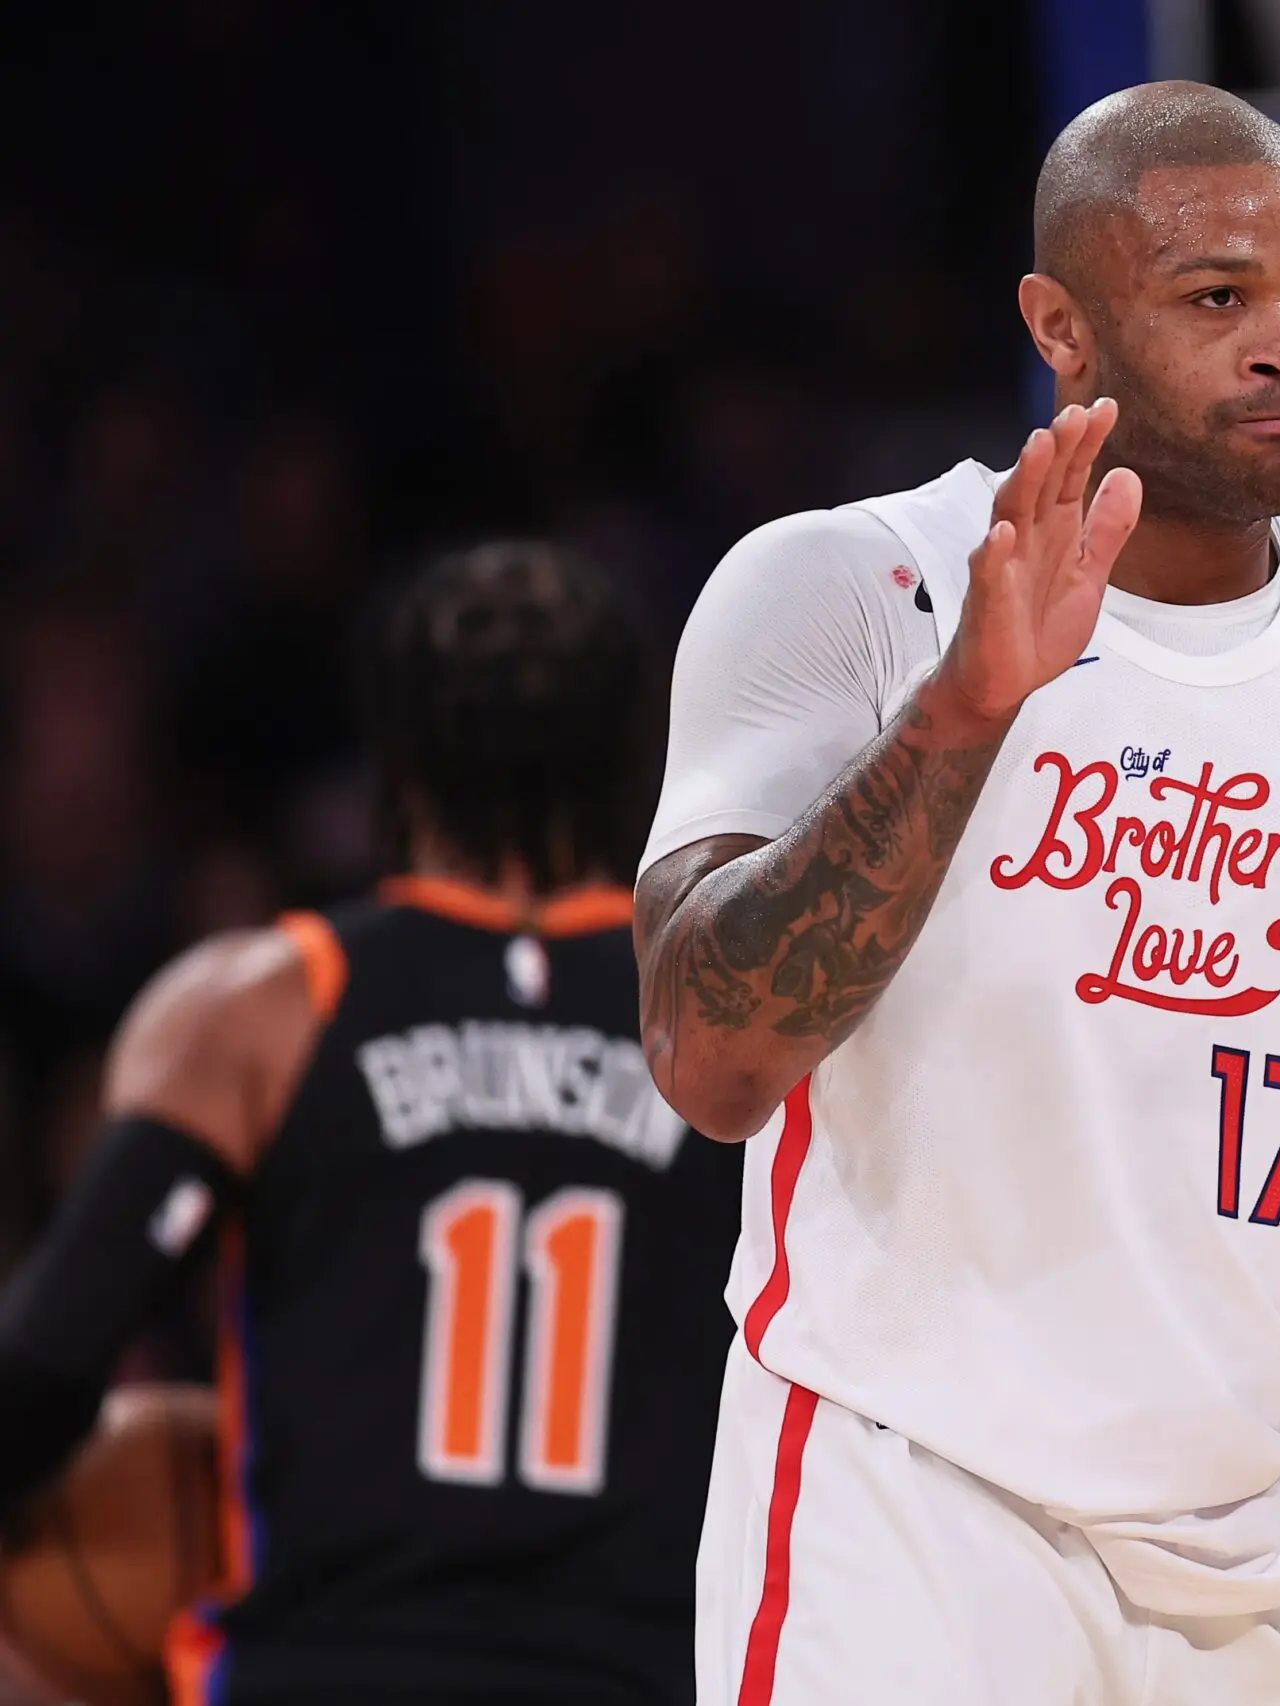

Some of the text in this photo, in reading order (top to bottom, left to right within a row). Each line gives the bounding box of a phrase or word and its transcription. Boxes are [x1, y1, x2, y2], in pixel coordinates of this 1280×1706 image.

[1120, 746, 1172, 781] City of
[418, 1180, 623, 1495] 11
